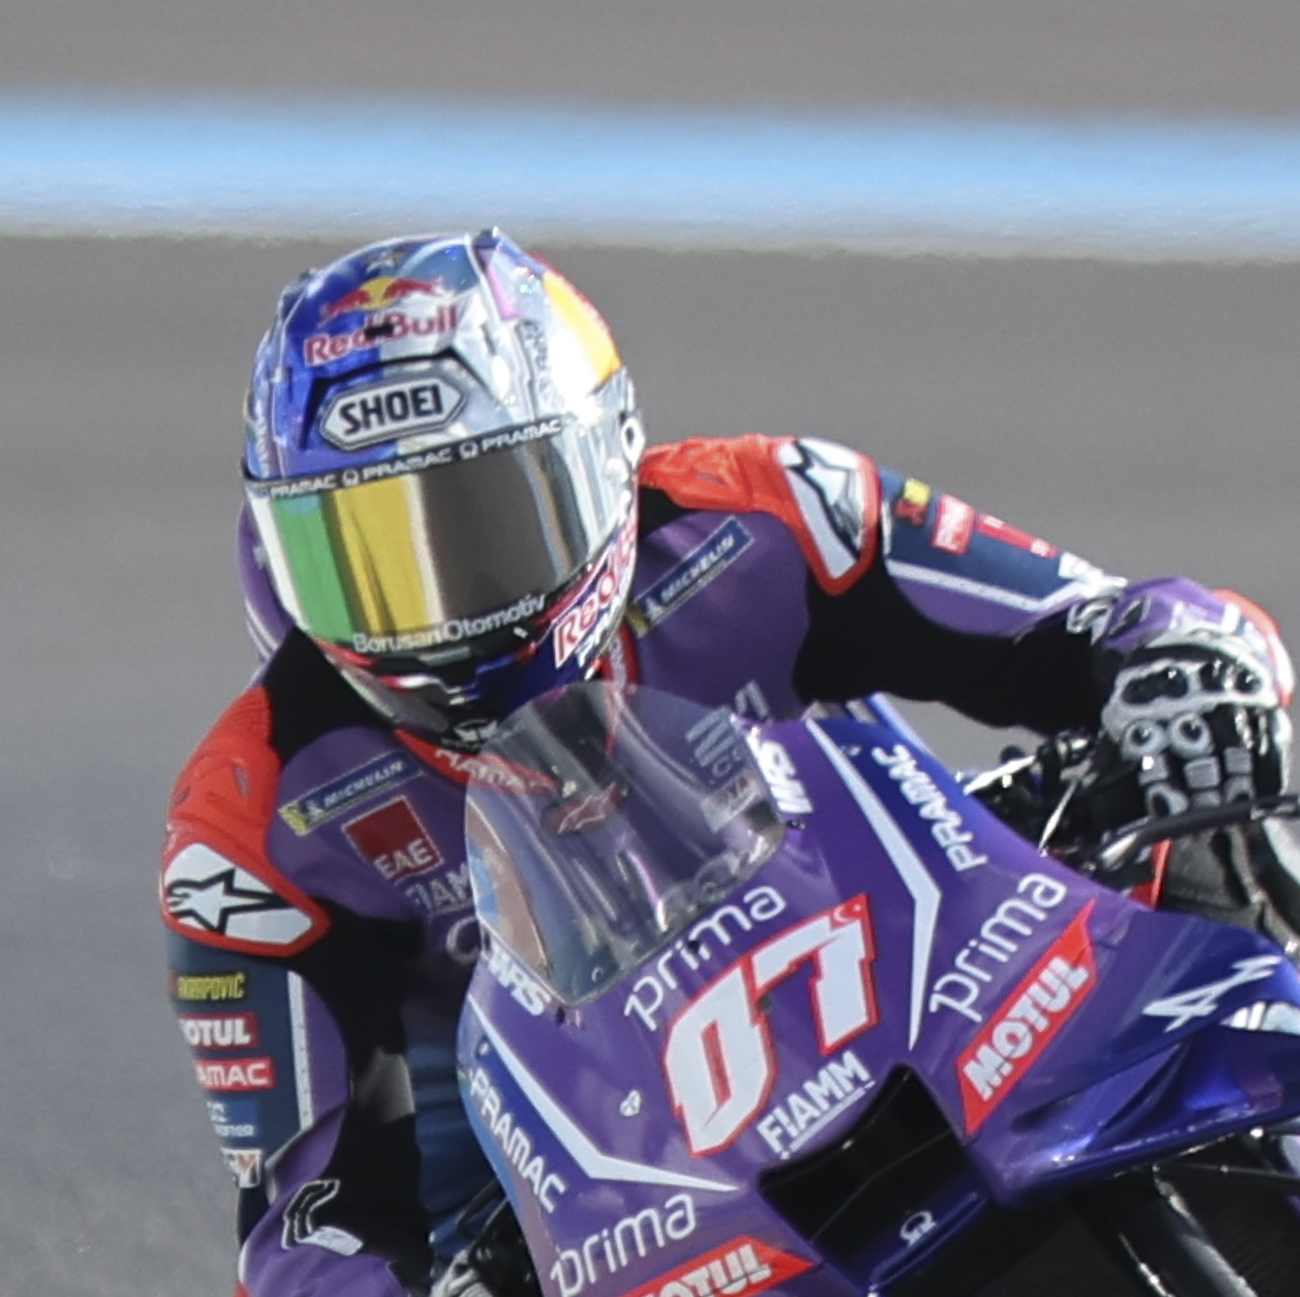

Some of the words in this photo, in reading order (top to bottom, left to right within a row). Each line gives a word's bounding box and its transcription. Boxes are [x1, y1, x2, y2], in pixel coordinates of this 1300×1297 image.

[304, 311, 375, 366] Red
[384, 304, 460, 338] Bull
[339, 383, 443, 435] SHOEI
[363, 449, 452, 480] PRAMAC
[481, 420, 562, 452] PRAMAC
[373, 838, 433, 881] EAE
[624, 885, 786, 1031] prima
[929, 872, 1068, 1023] prima
[178, 1018, 251, 1047] OTUL
[663, 893, 878, 1158] 07
[962, 956, 1090, 1101] MOTUL
[470, 1070, 567, 1213] PRAMAC
[757, 1050, 872, 1158] FIAMM
